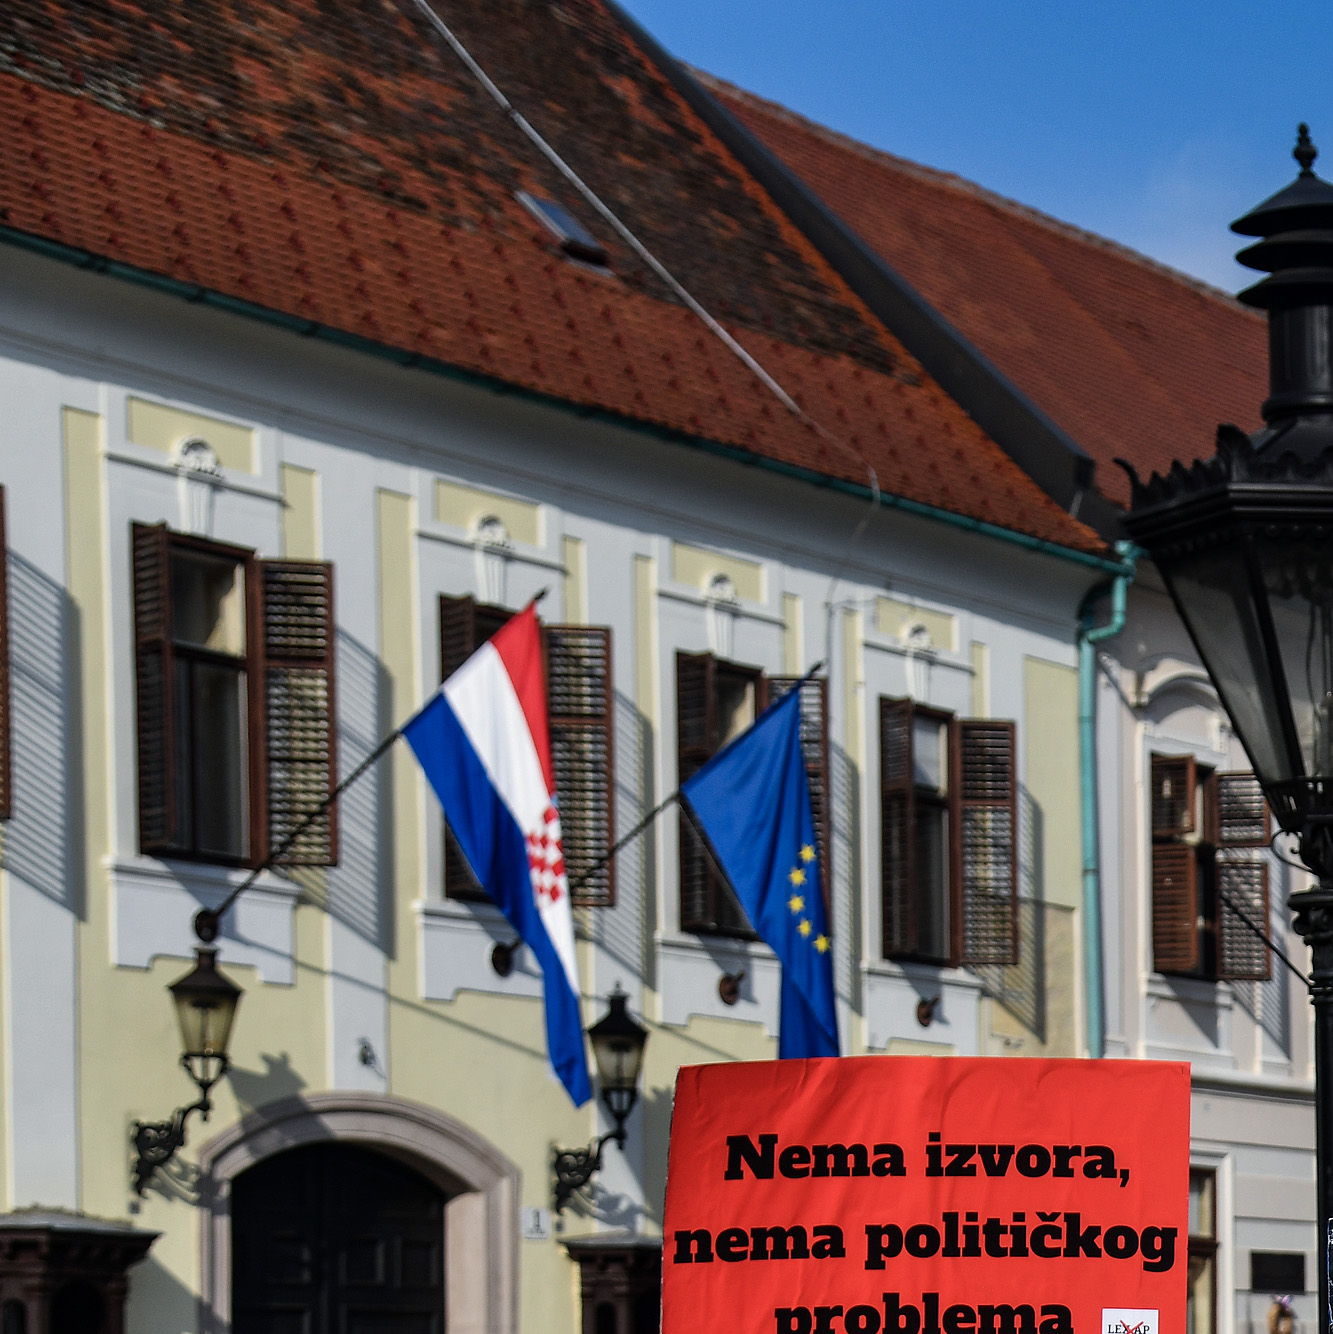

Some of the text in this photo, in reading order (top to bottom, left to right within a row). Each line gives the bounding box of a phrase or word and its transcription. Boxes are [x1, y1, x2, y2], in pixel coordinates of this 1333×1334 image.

[724, 1131, 1130, 1188] Nema izvora,
[673, 1211, 1178, 1273] nema političkog
